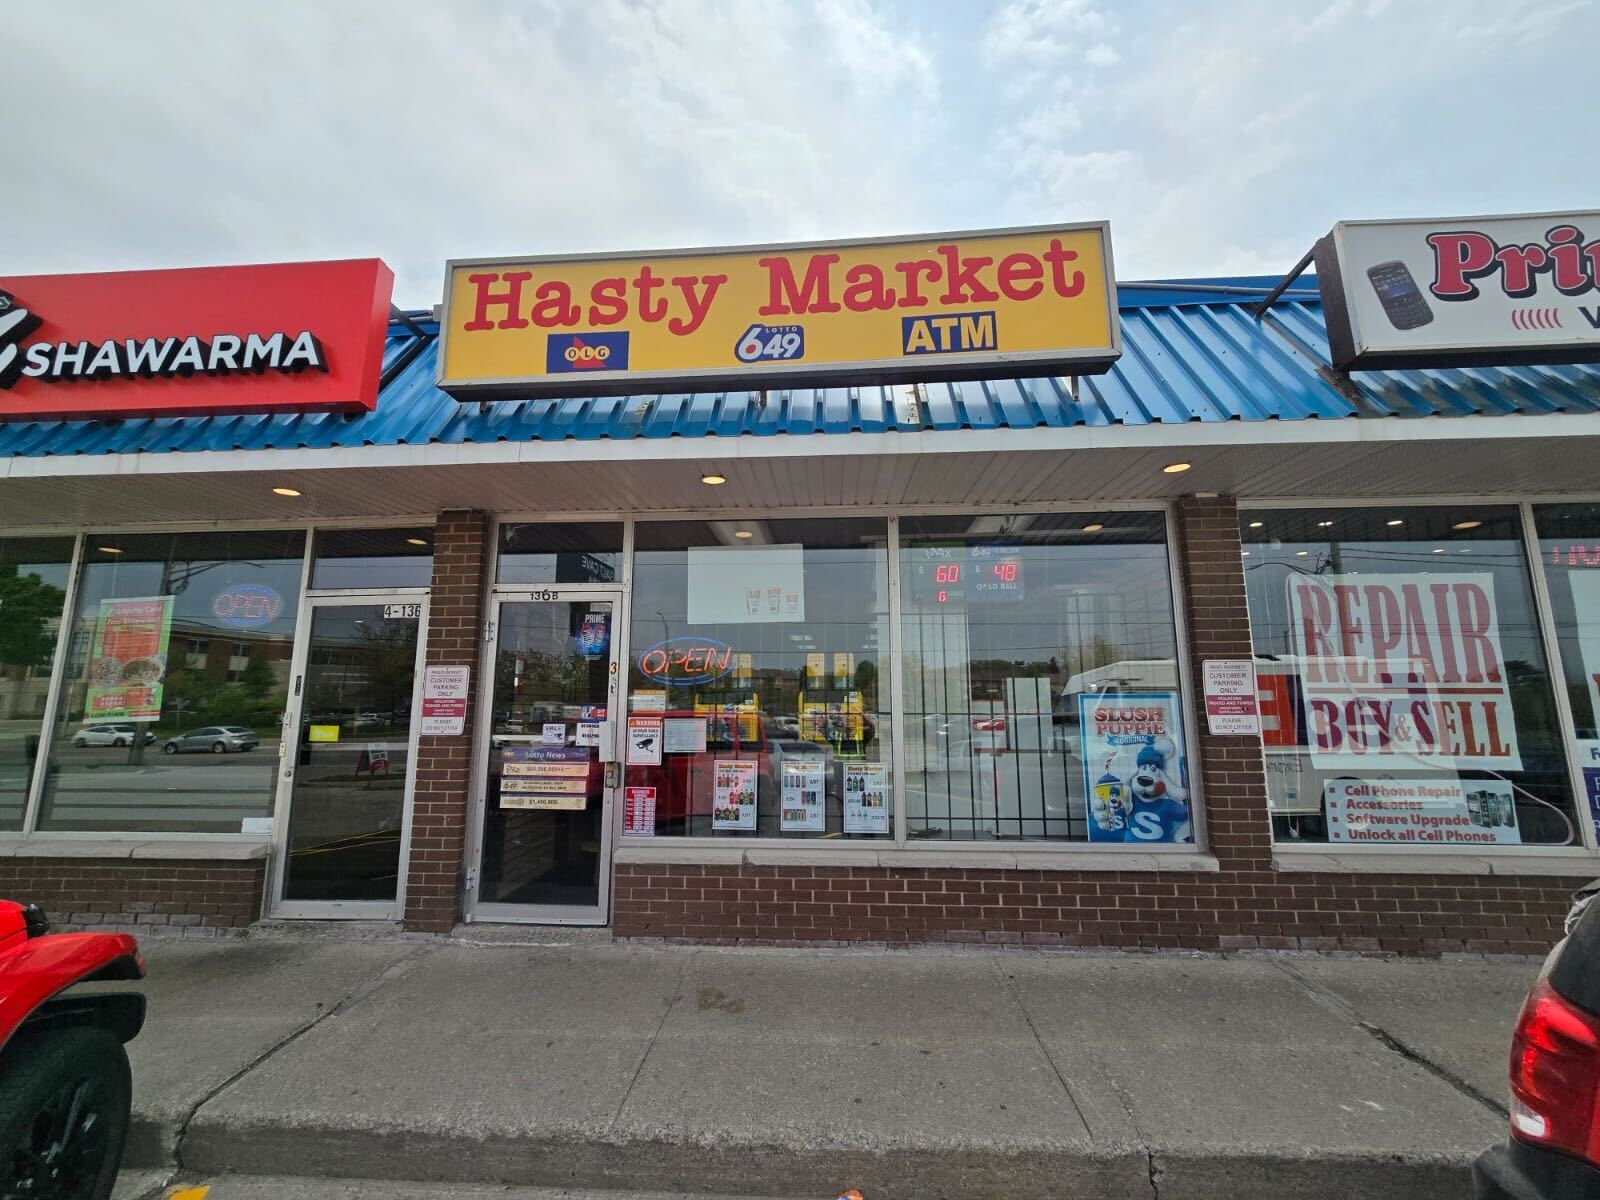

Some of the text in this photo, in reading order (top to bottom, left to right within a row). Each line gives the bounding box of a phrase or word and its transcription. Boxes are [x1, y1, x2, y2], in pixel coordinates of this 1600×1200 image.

[463, 238, 1086, 336] Hasty Market
[905, 313, 994, 353] ATM
[22, 331, 320, 377] SHAWARMA
[566, 347, 607, 359] OLG
[936, 565, 959, 582] 60
[994, 564, 1016, 581] 48
[214, 594, 280, 621] OPEN
[384, 605, 422, 617] 4-136
[585, 614, 605, 624] PRIME
[1296, 583, 1503, 684] REPAIR
[642, 646, 732, 674] OPEN
[1094, 707, 1164, 722] SLUSH
[1415, 700, 1512, 757] SELL
[526, 752, 544, 760] Lotto
[1345, 785, 1461, 798] Cell Phone Repair
[1346, 799, 1424, 810] Accessories
[1346, 814, 1470, 828] Software Upgrade
[1349, 829, 1497, 842] Unlock all Cell Phones
